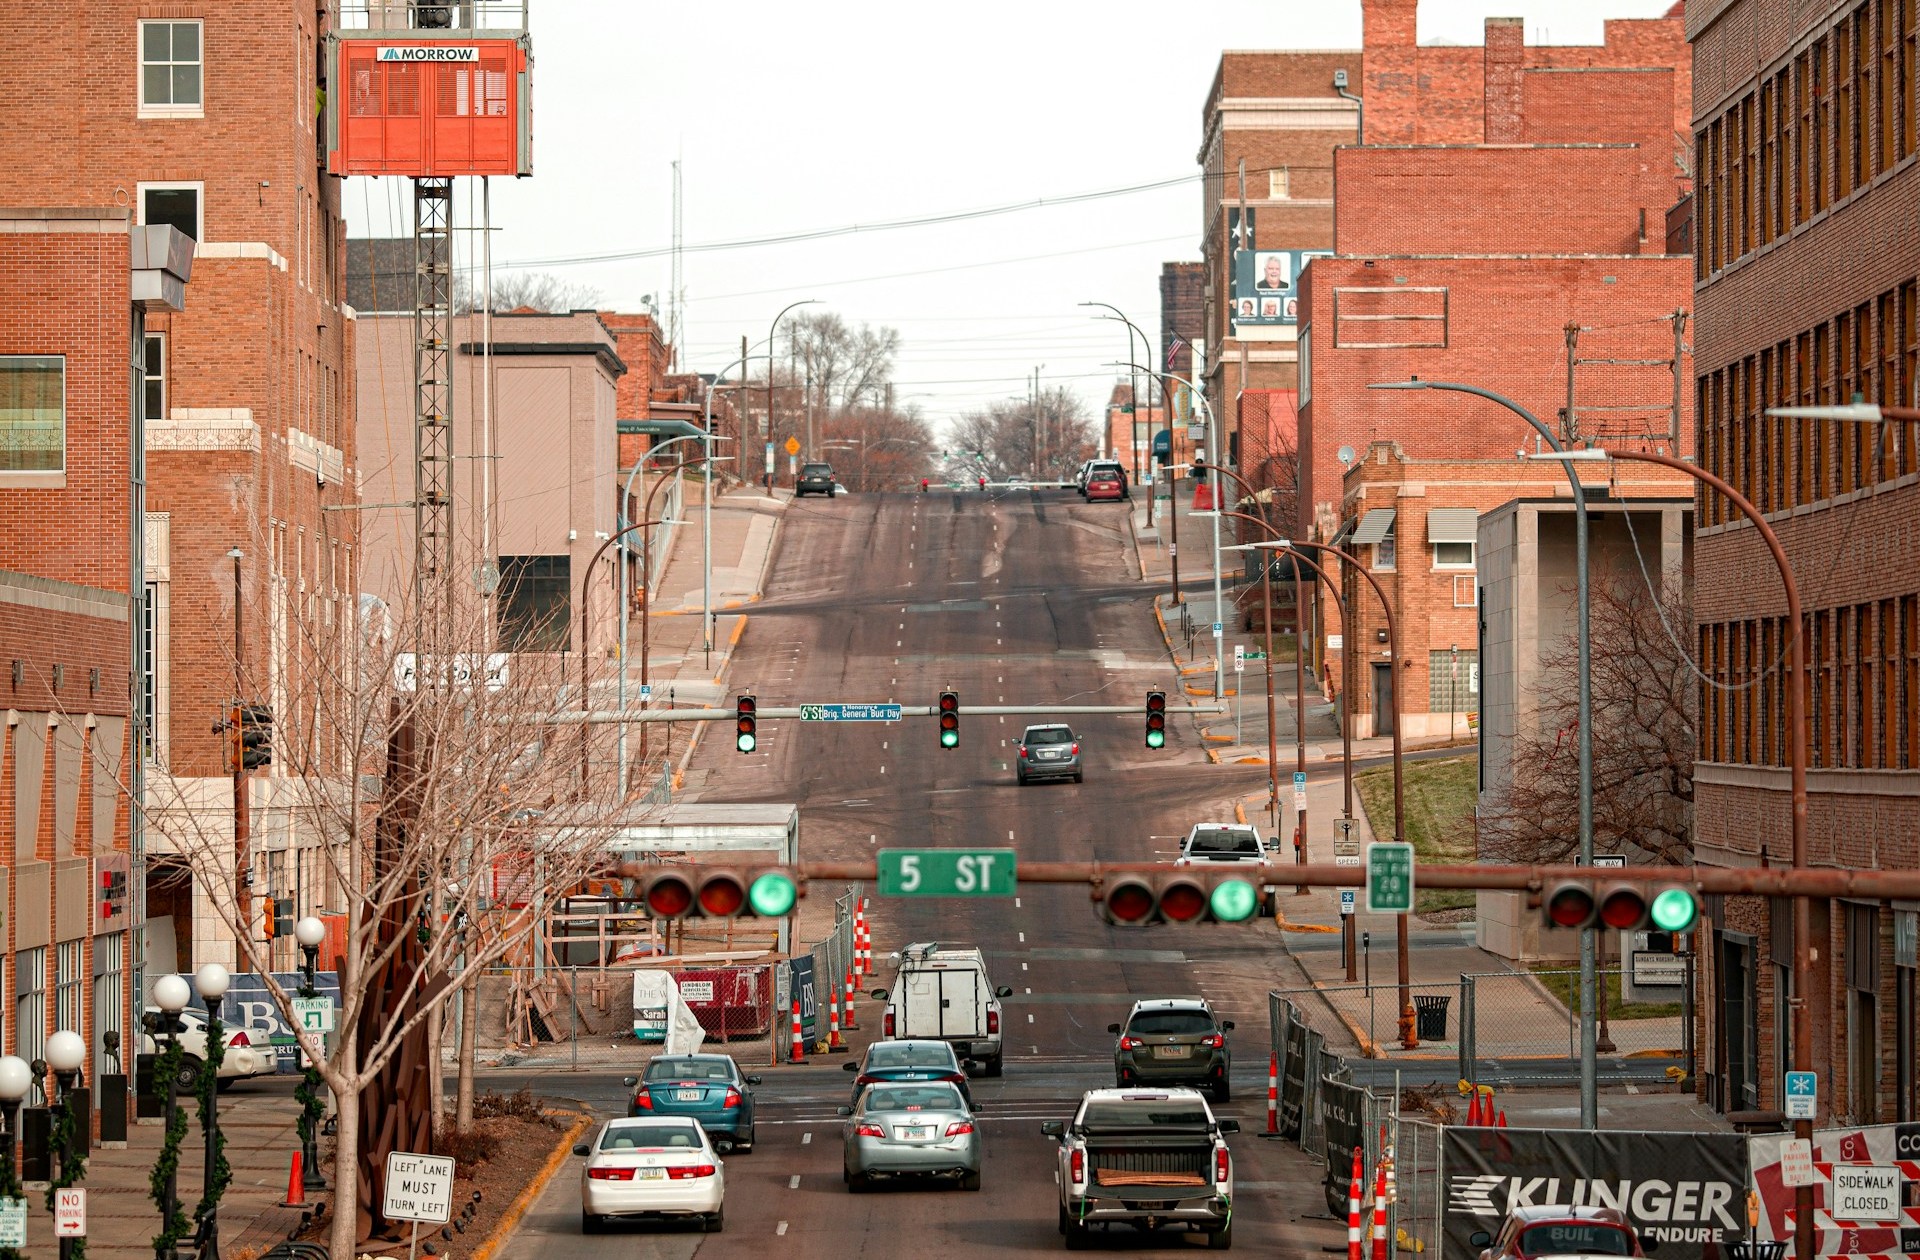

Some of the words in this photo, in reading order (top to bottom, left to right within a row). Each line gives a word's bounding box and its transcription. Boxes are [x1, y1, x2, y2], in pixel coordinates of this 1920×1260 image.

[401, 49, 473, 60] MORROW
[811, 706, 822, 720] St
[842, 709, 867, 718] General
[870, 709, 884, 718] Bud
[887, 709, 900, 719] Day
[900, 855, 921, 892] 5
[955, 855, 996, 892] ST
[639, 989, 657, 999] THE
[295, 1000, 329, 1010] PARKING
[642, 1009, 667, 1020] Sarah
[1842, 1137, 1855, 1160] Co.
[394, 1161, 417, 1173] LEFT
[423, 1164, 448, 1176] LANE
[402, 1180, 437, 1195] MUST
[1838, 1175, 1894, 1189] SIDEWALK
[62, 1194, 79, 1206] NO
[390, 1198, 415, 1210] TURN
[421, 1202, 445, 1214] LEFT
[1505, 1176, 1740, 1230] KLINGER
[1844, 1196, 1888, 1210] CLOSED
[60, 1208, 82, 1218] PARKING
[1643, 1227, 1724, 1243] ENDURE
